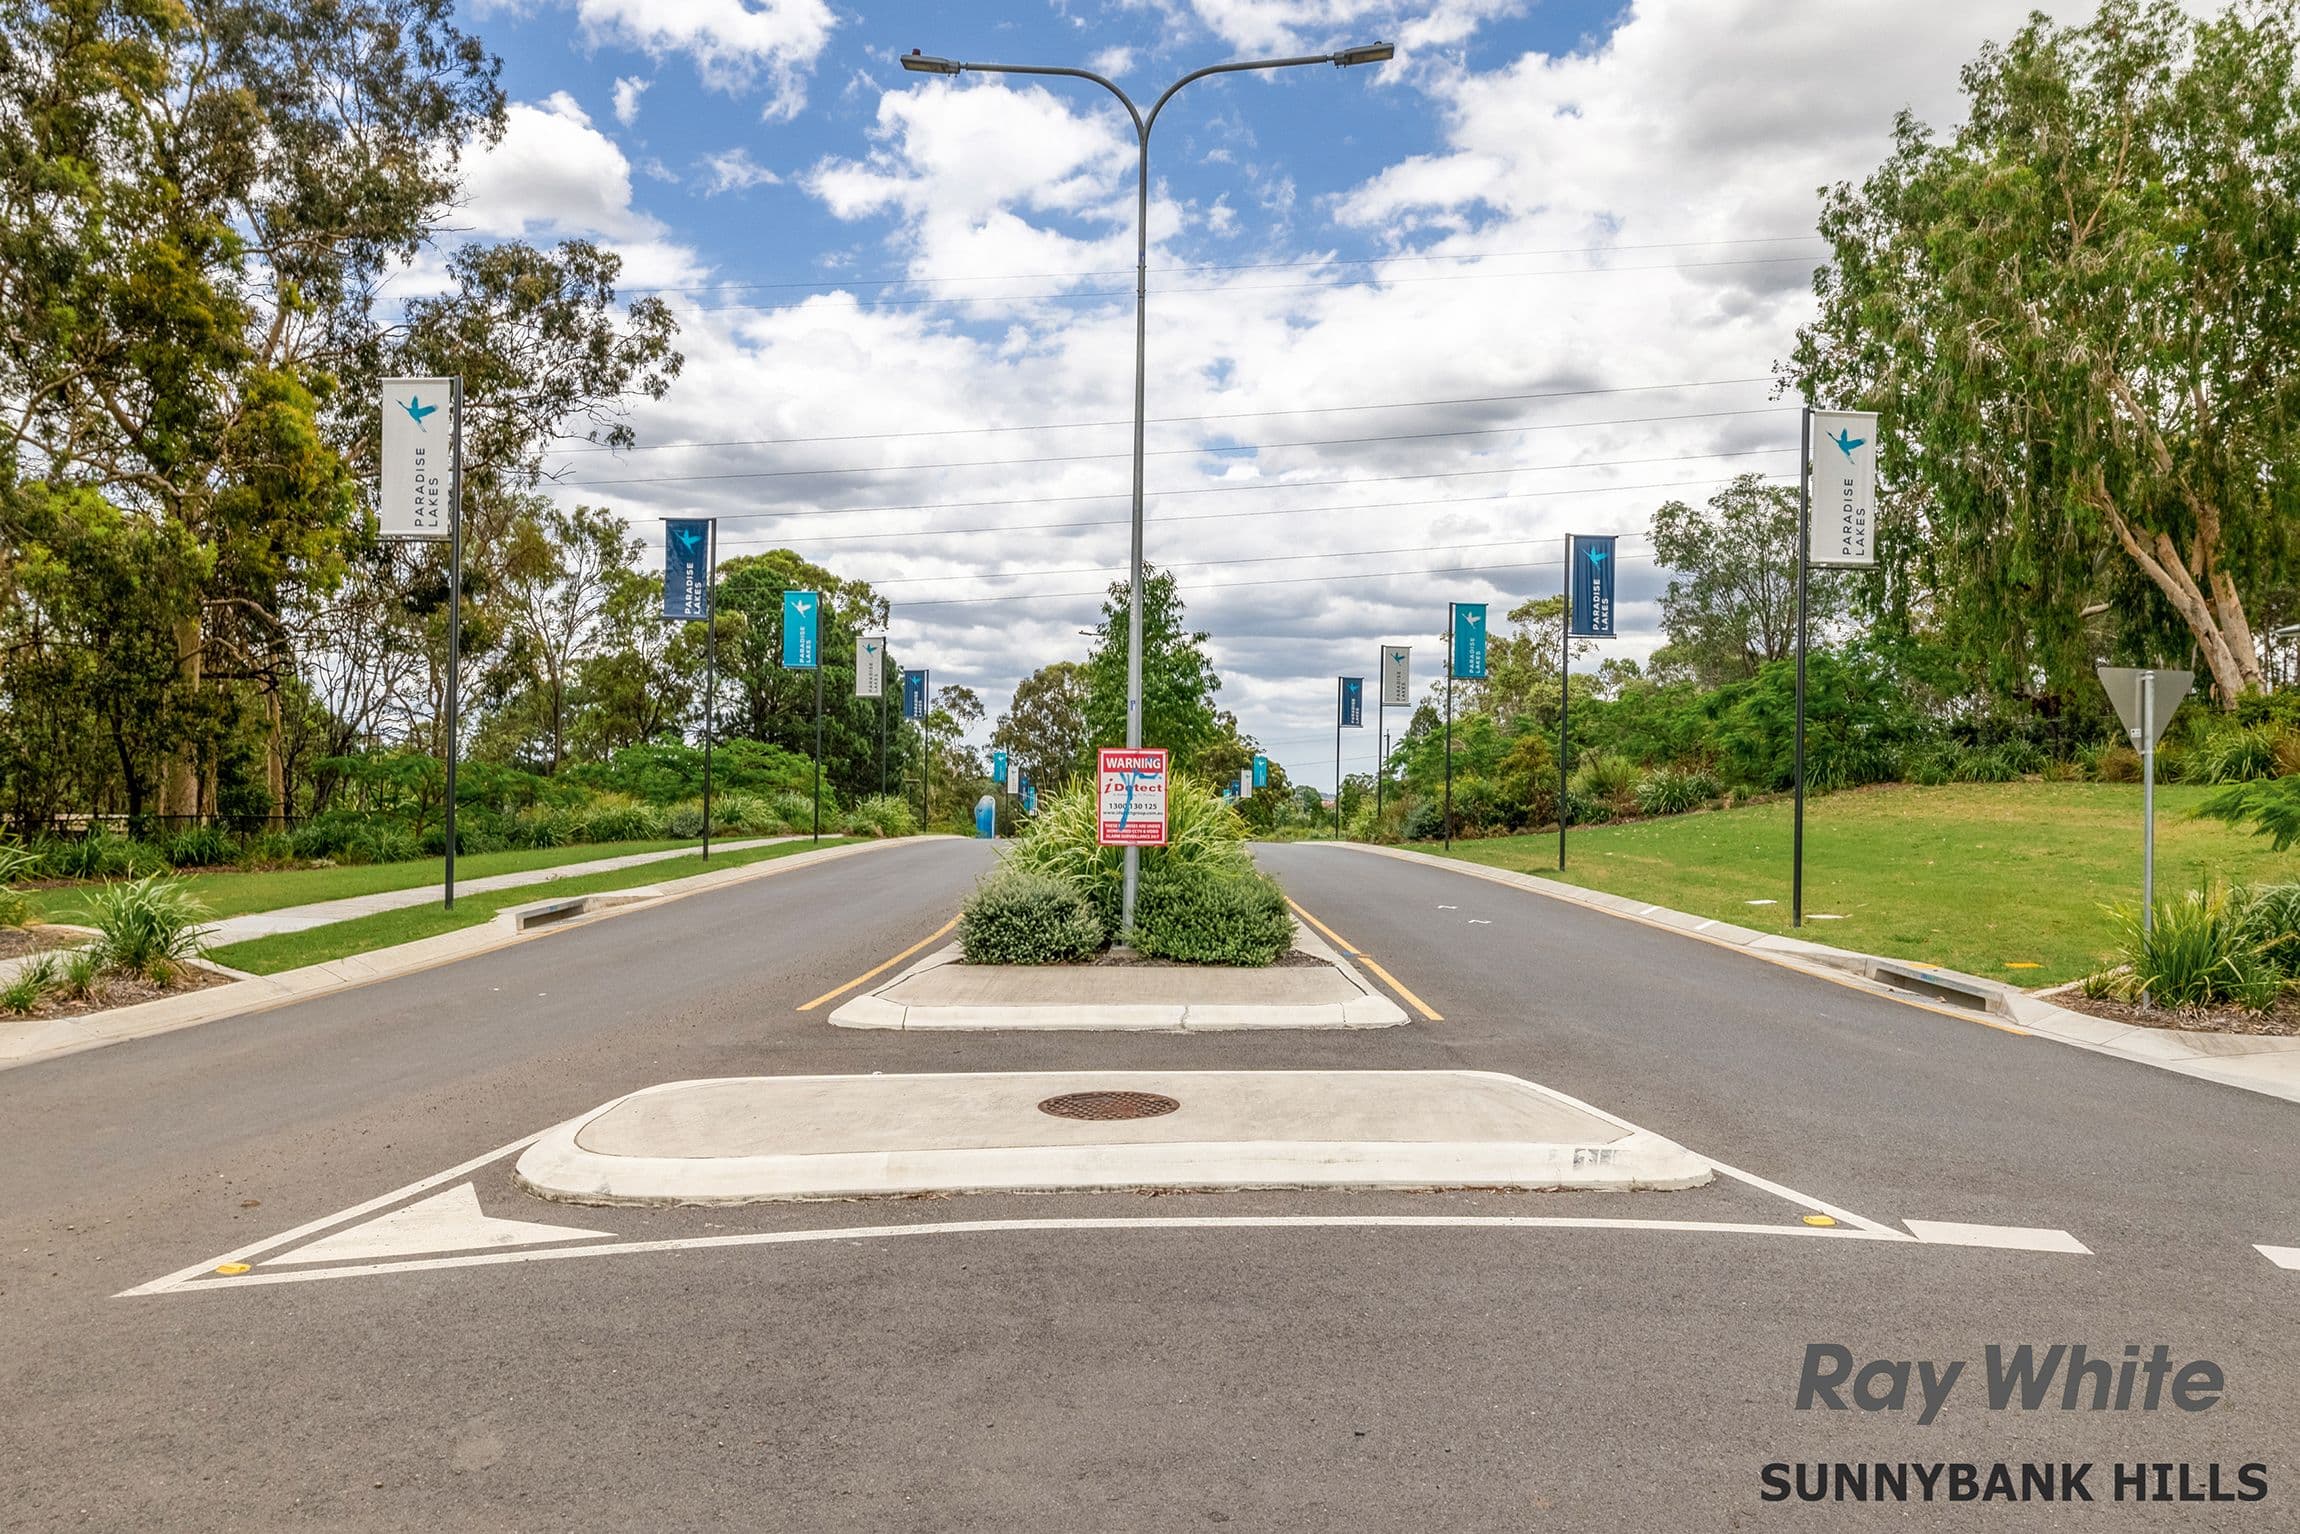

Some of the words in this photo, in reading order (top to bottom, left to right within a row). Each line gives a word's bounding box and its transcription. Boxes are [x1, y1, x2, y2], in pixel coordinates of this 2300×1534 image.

[415, 447, 425, 527] PARADISE
[429, 477, 438, 527] LAKES
[1843, 479, 1853, 555] PARADISE
[1856, 508, 1866, 556] LAKES
[685, 562, 694, 614] PARADISE
[694, 582, 702, 615] LAKES
[1593, 578, 1601, 631] PARADISE
[1601, 598, 1609, 631] LAKES
[1106, 758, 1161, 769] WARNING
